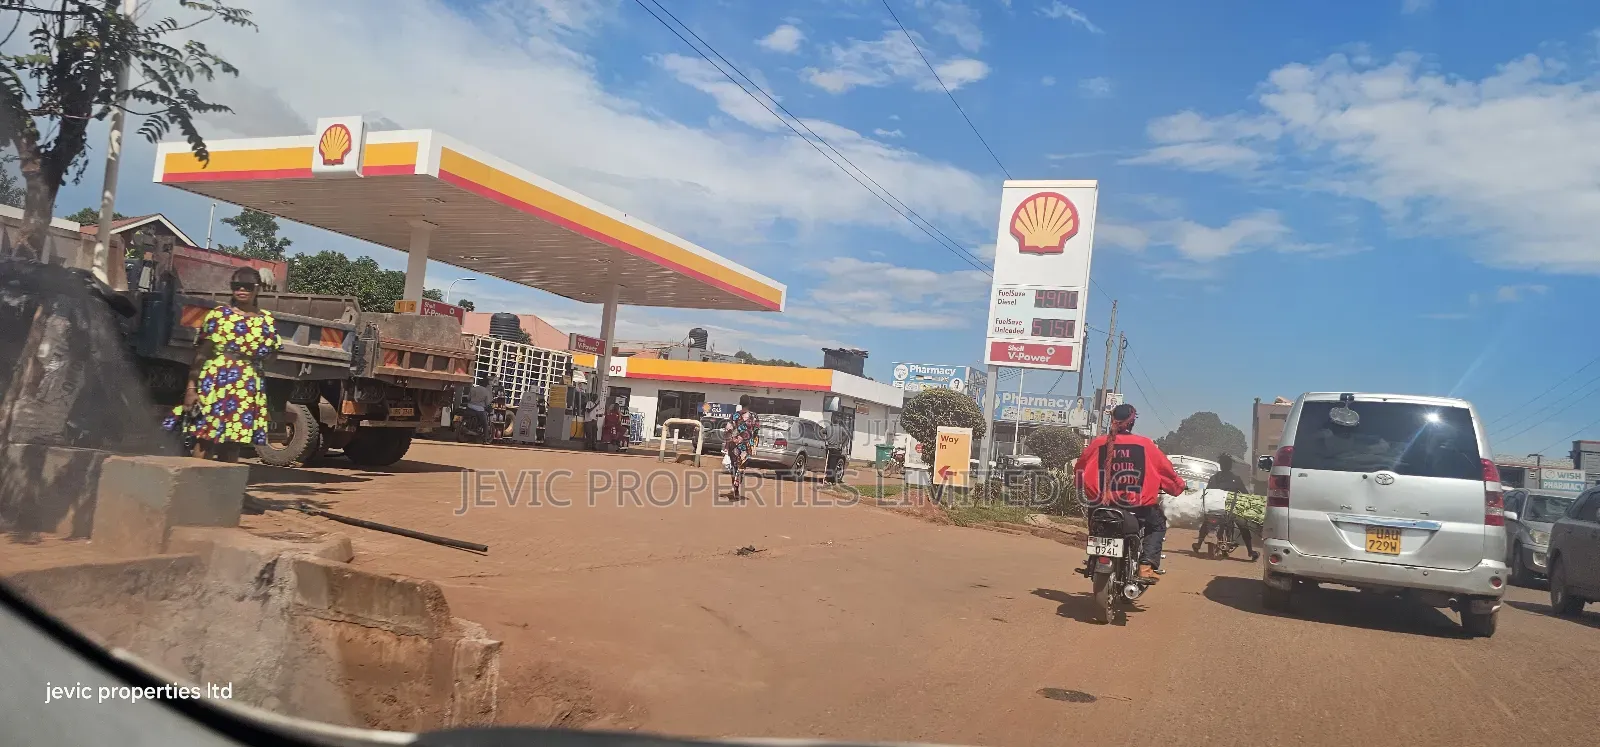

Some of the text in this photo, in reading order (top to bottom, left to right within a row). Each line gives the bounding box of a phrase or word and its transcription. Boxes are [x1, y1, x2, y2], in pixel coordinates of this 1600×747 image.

[998, 289, 1026, 297] FuelSave
[997, 298, 1017, 306] Diesel
[1035, 290, 1078, 308] 4900
[424, 308, 451, 317] V-Po
[995, 317, 1023, 326] FuelSave
[994, 326, 1025, 334] Unleaded
[1007, 344, 1025, 352] Shell
[1007, 351, 1051, 363] V-Power
[610, 365, 622, 375] op
[909, 364, 957, 377] Pharmacy
[1002, 392, 1073, 410] Pharmacy
[940, 434, 960, 445] Way
[1112, 462, 1135, 471] OUR
[1556, 471, 1582, 480] WISH
[1117, 476, 1139, 486] ODY
[1543, 481, 1585, 491] PHARMACY
[1376, 528, 1400, 541] UAU
[1368, 539, 1398, 553] 729W
